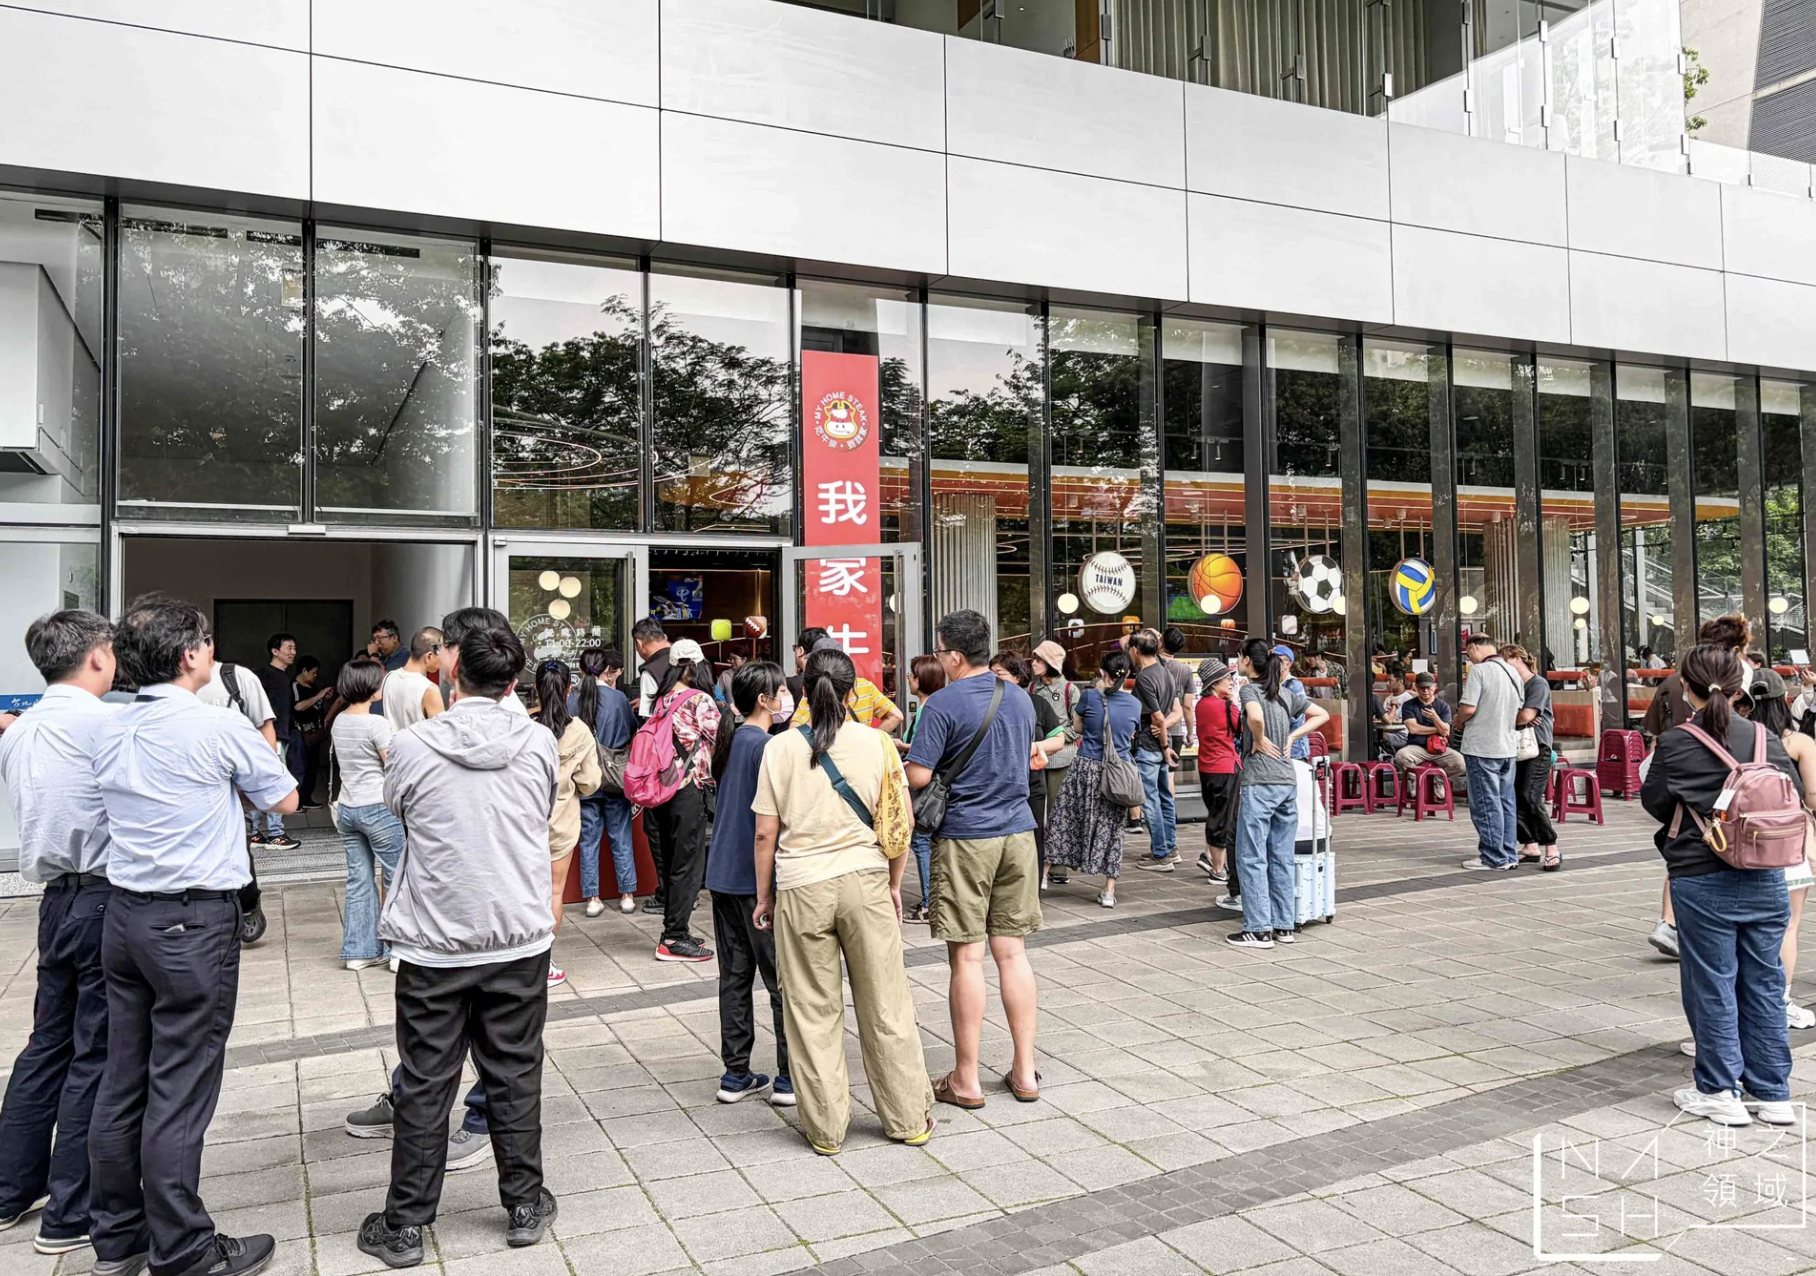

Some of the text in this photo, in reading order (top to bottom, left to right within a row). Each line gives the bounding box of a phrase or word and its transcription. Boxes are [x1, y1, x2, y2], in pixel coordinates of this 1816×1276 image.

[813, 391, 868, 422] MY HOME STEAK
[1095, 574, 1123, 587] TAIWAN
[525, 617, 551, 632] HOME
